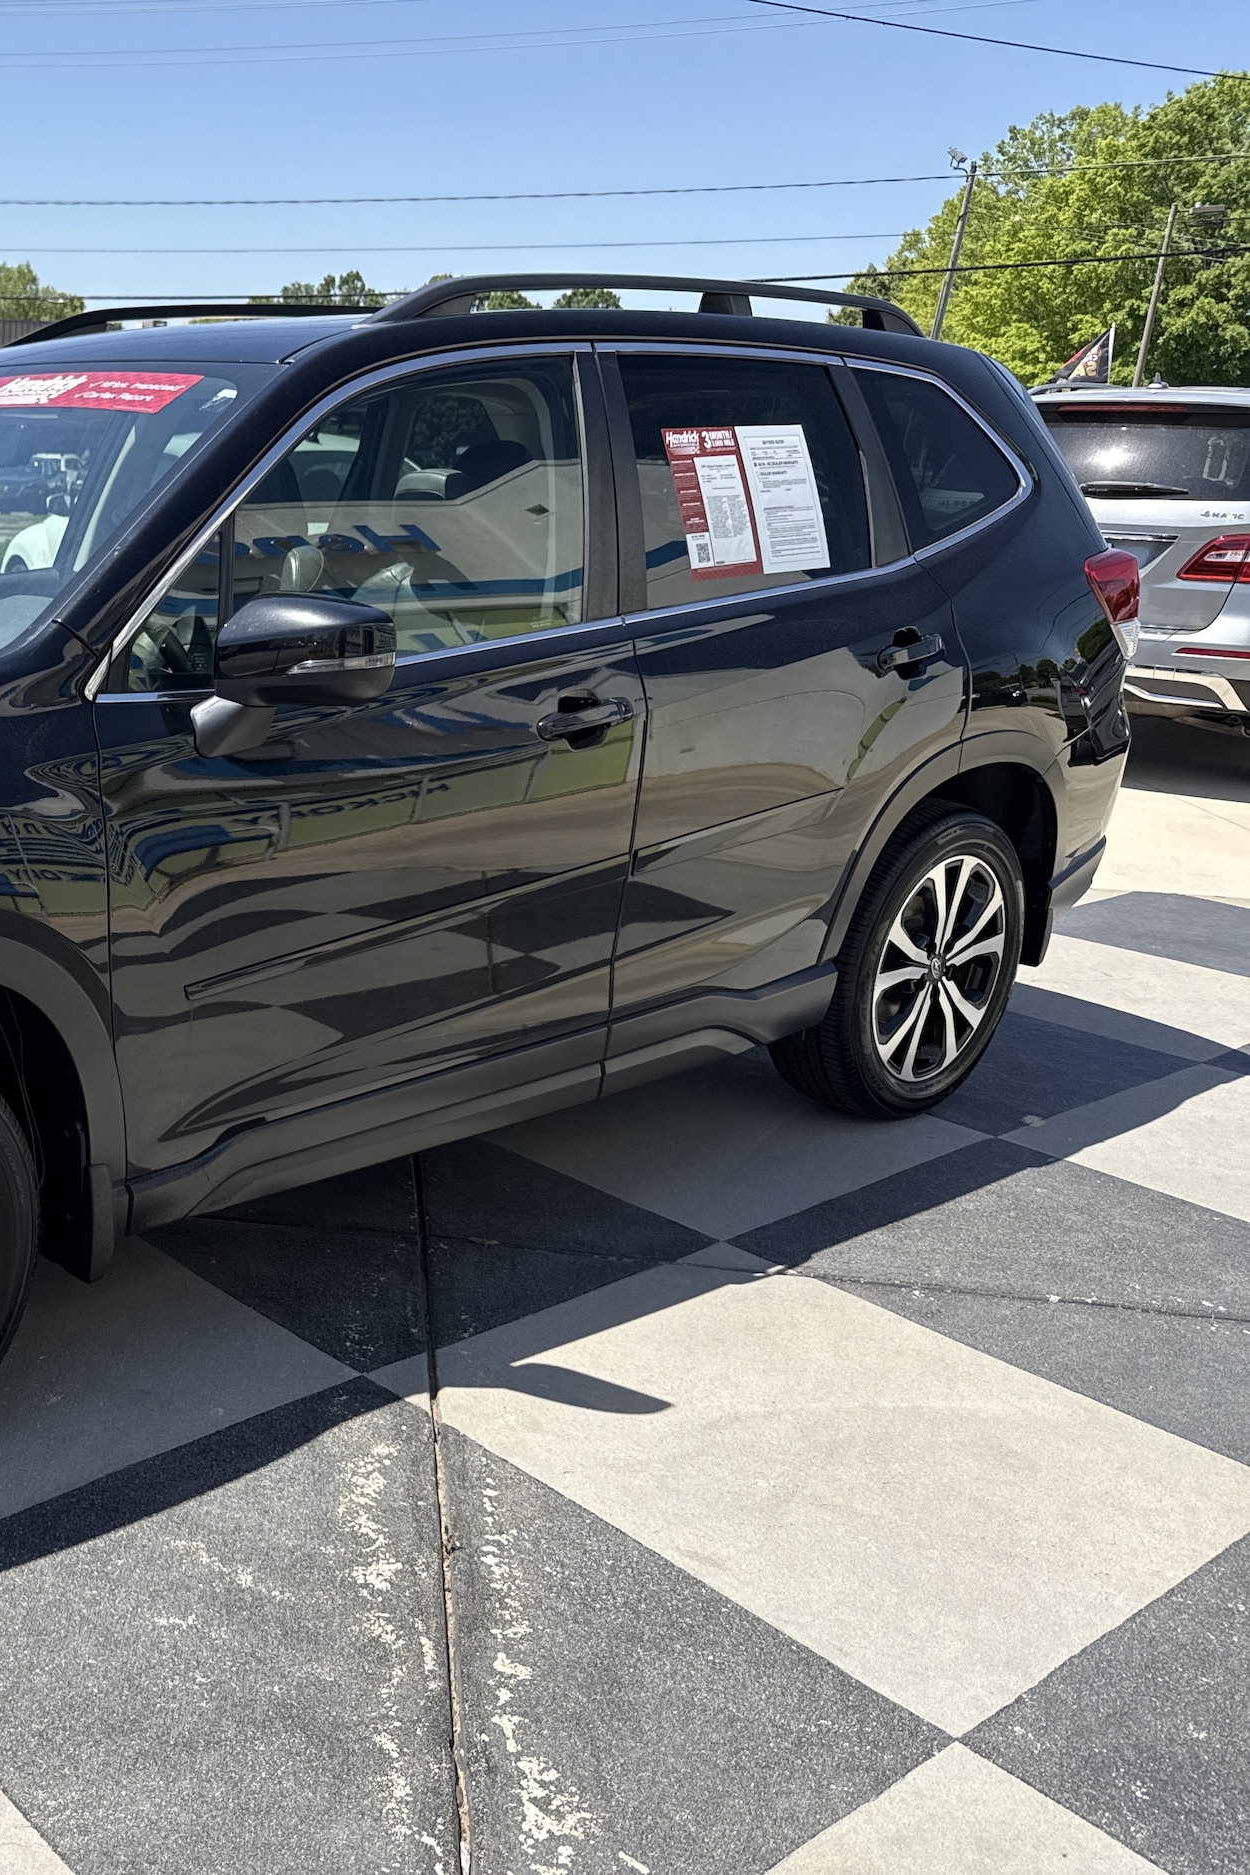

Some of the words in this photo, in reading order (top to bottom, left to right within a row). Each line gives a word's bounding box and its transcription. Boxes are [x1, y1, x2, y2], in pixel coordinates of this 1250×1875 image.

[665, 430, 699, 448] Hendrick
[701, 430, 711, 449] 3
[1200, 511, 1245, 520] 4MAIC
